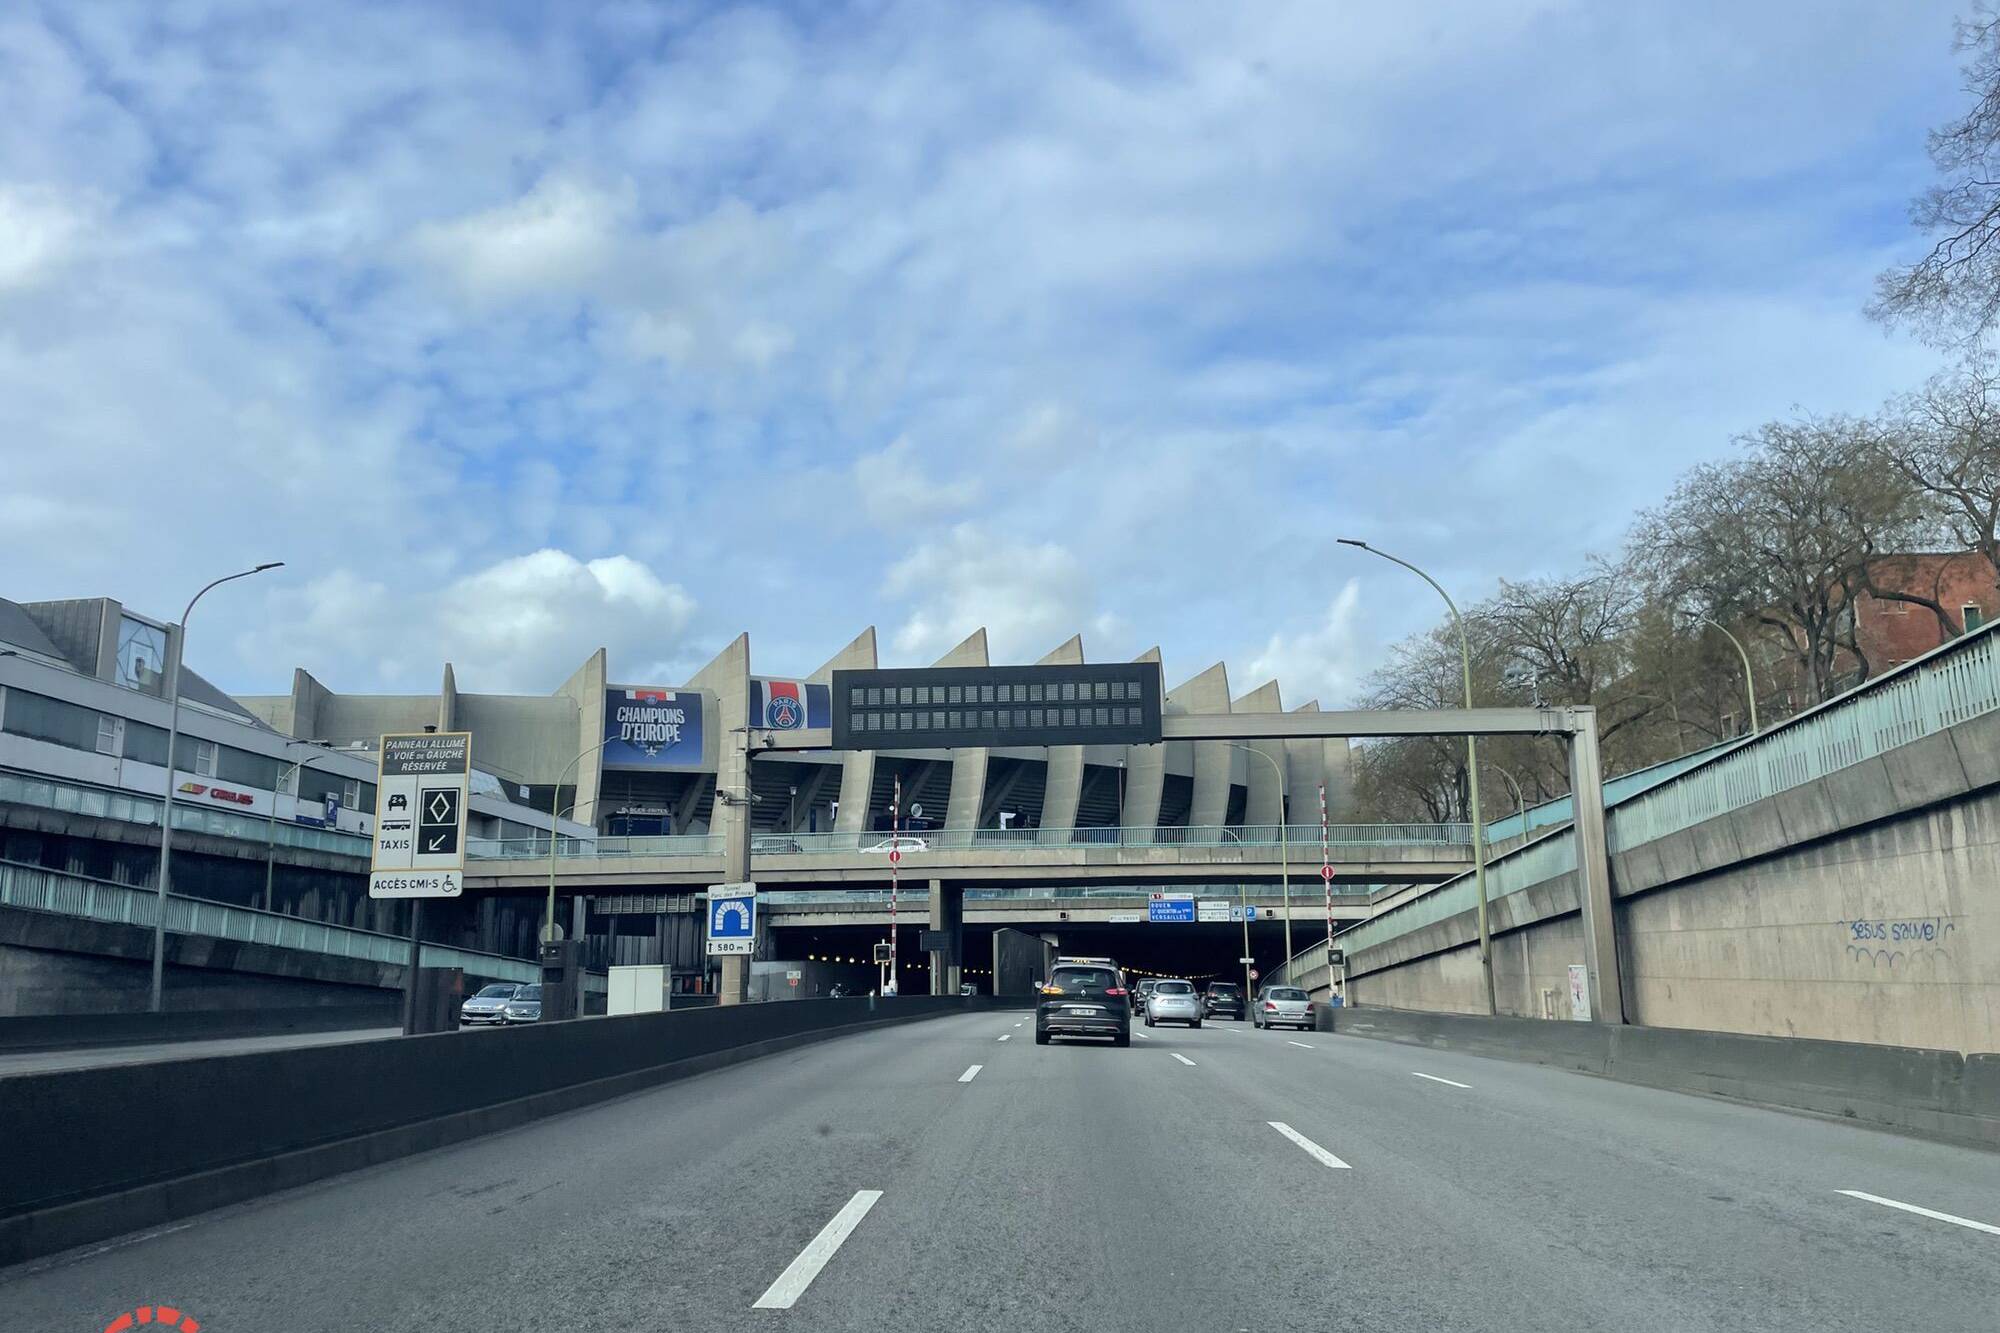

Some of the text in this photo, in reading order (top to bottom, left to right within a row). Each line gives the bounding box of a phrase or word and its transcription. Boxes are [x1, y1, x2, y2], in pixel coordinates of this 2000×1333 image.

[773, 699, 797, 708] PARIS
[616, 706, 686, 724] CHAMPIONS
[620, 722, 682, 742] D'EUROPE
[385, 738, 466, 750] PANNEAU ALLUMÉ
[393, 751, 416, 760] VOIE
[426, 750, 464, 760] GAUCHE
[401, 760, 448, 771] RÉSERVÉE
[391, 796, 404, 804] 2+
[327, 800, 335, 814] P
[380, 840, 410, 850] TAXIS
[373, 877, 439, 890] ACCÈS CMI-S
[1246, 908, 1254, 916] P
[717, 943, 735, 951] 580
